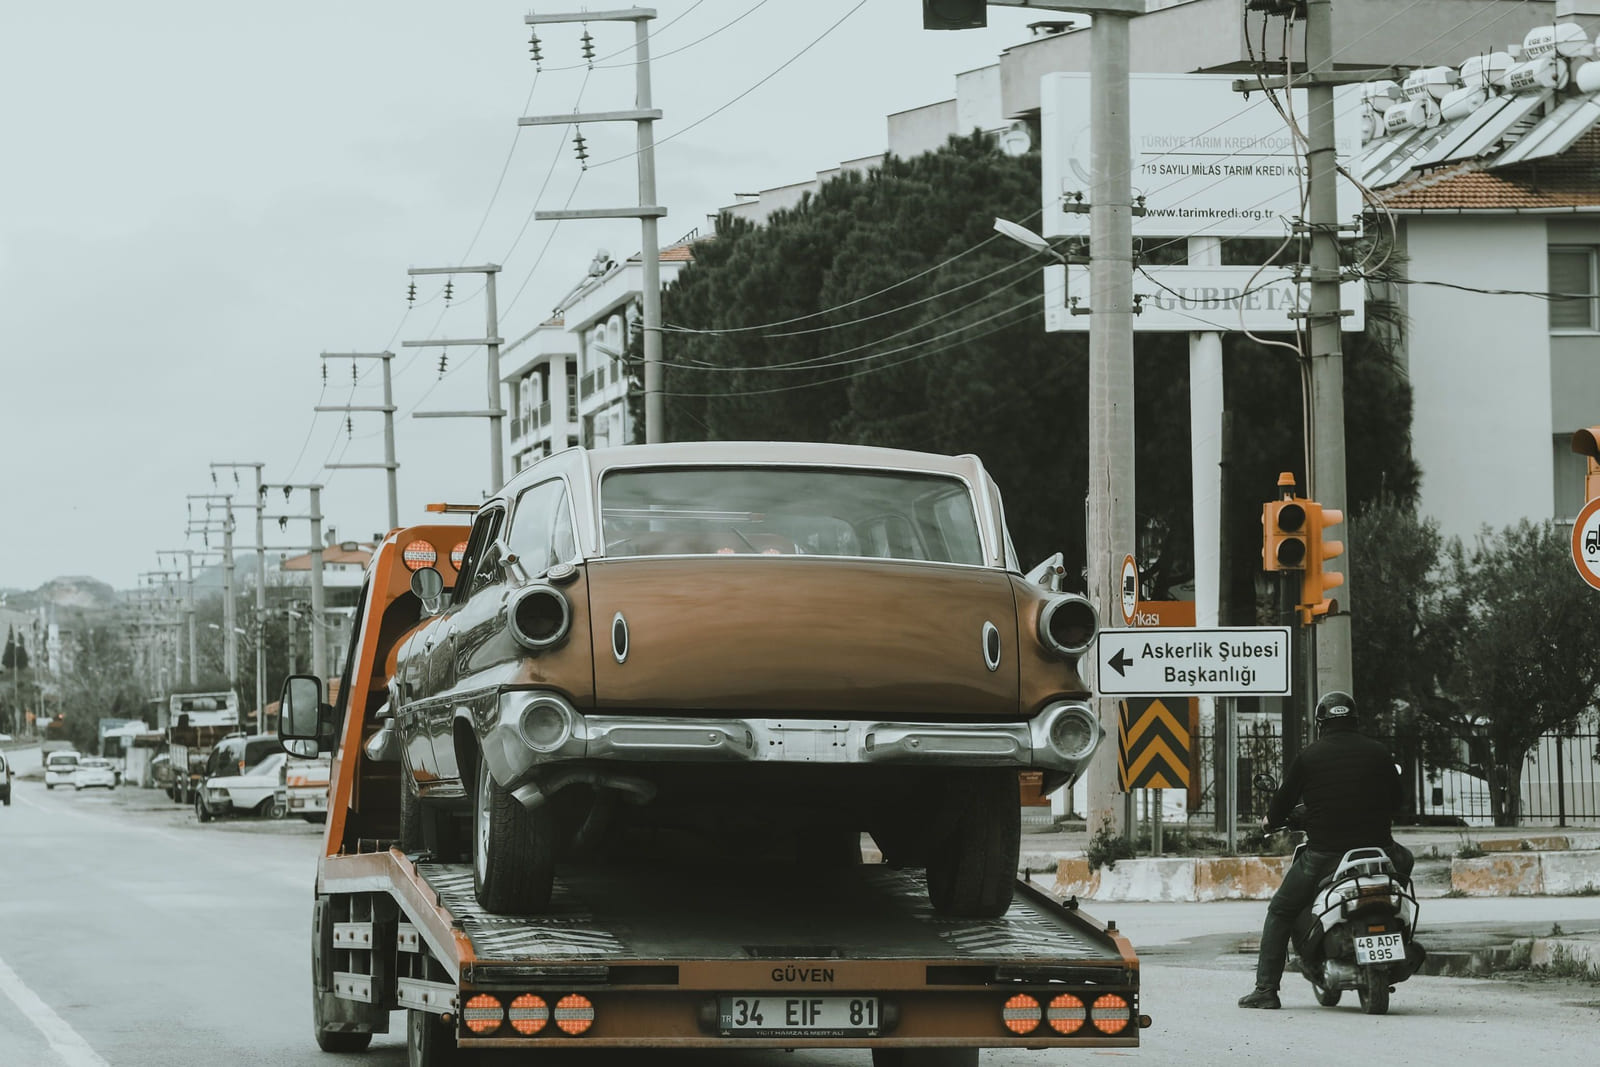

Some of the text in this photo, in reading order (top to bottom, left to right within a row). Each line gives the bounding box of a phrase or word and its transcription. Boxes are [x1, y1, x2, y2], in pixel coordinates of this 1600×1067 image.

[1140, 134, 1186, 148] TÜRKİYE
[1189, 136, 1222, 148] TARIM
[1224, 135, 1257, 149] KREDİ
[1141, 164, 1157, 175] 719
[1159, 164, 1190, 175] SAYILI
[1192, 162, 1222, 176] MİLAS
[1224, 165, 1253, 176] TARIM
[1255, 163, 1285, 177] KREDİ
[1146, 207, 1274, 221] www.tarimkredi.org.tr
[1141, 641, 1279, 662] Askerlik Şubesi
[1164, 665, 1256, 686] Başkanlığı
[1358, 935, 1400, 949] 48 ADF
[1369, 948, 1393, 961] 895
[771, 965, 834, 983] GÜVEN
[721, 999, 874, 1026] TR 34 EIF 81
